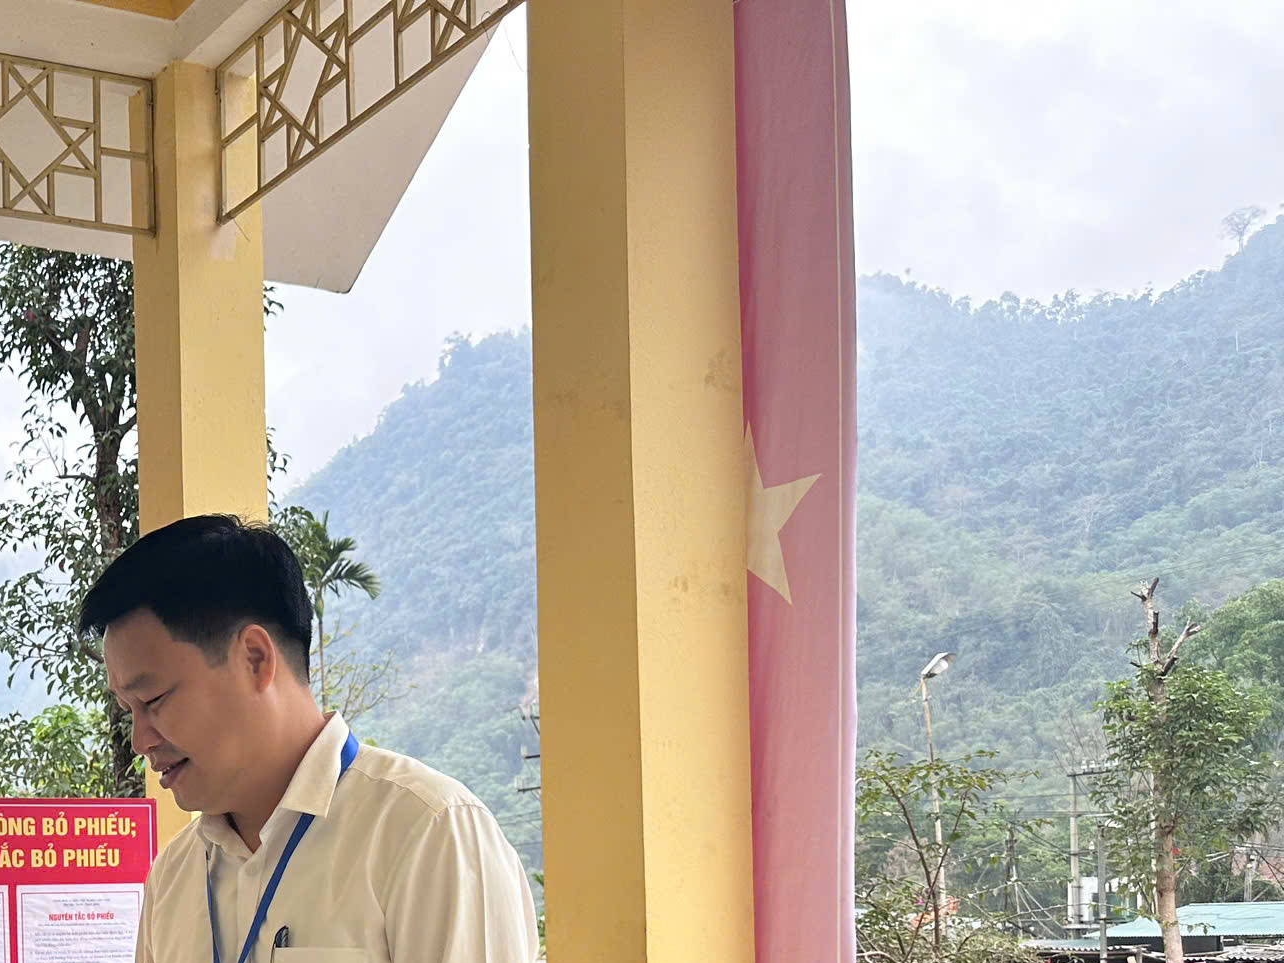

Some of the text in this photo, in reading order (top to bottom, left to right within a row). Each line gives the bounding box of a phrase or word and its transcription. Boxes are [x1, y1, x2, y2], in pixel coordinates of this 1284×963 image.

[42, 811, 68, 836] BỎ
[74, 811, 137, 838] PHIẾU;
[31, 842, 57, 868] BỎ
[63, 842, 120, 867] PHIẾU
